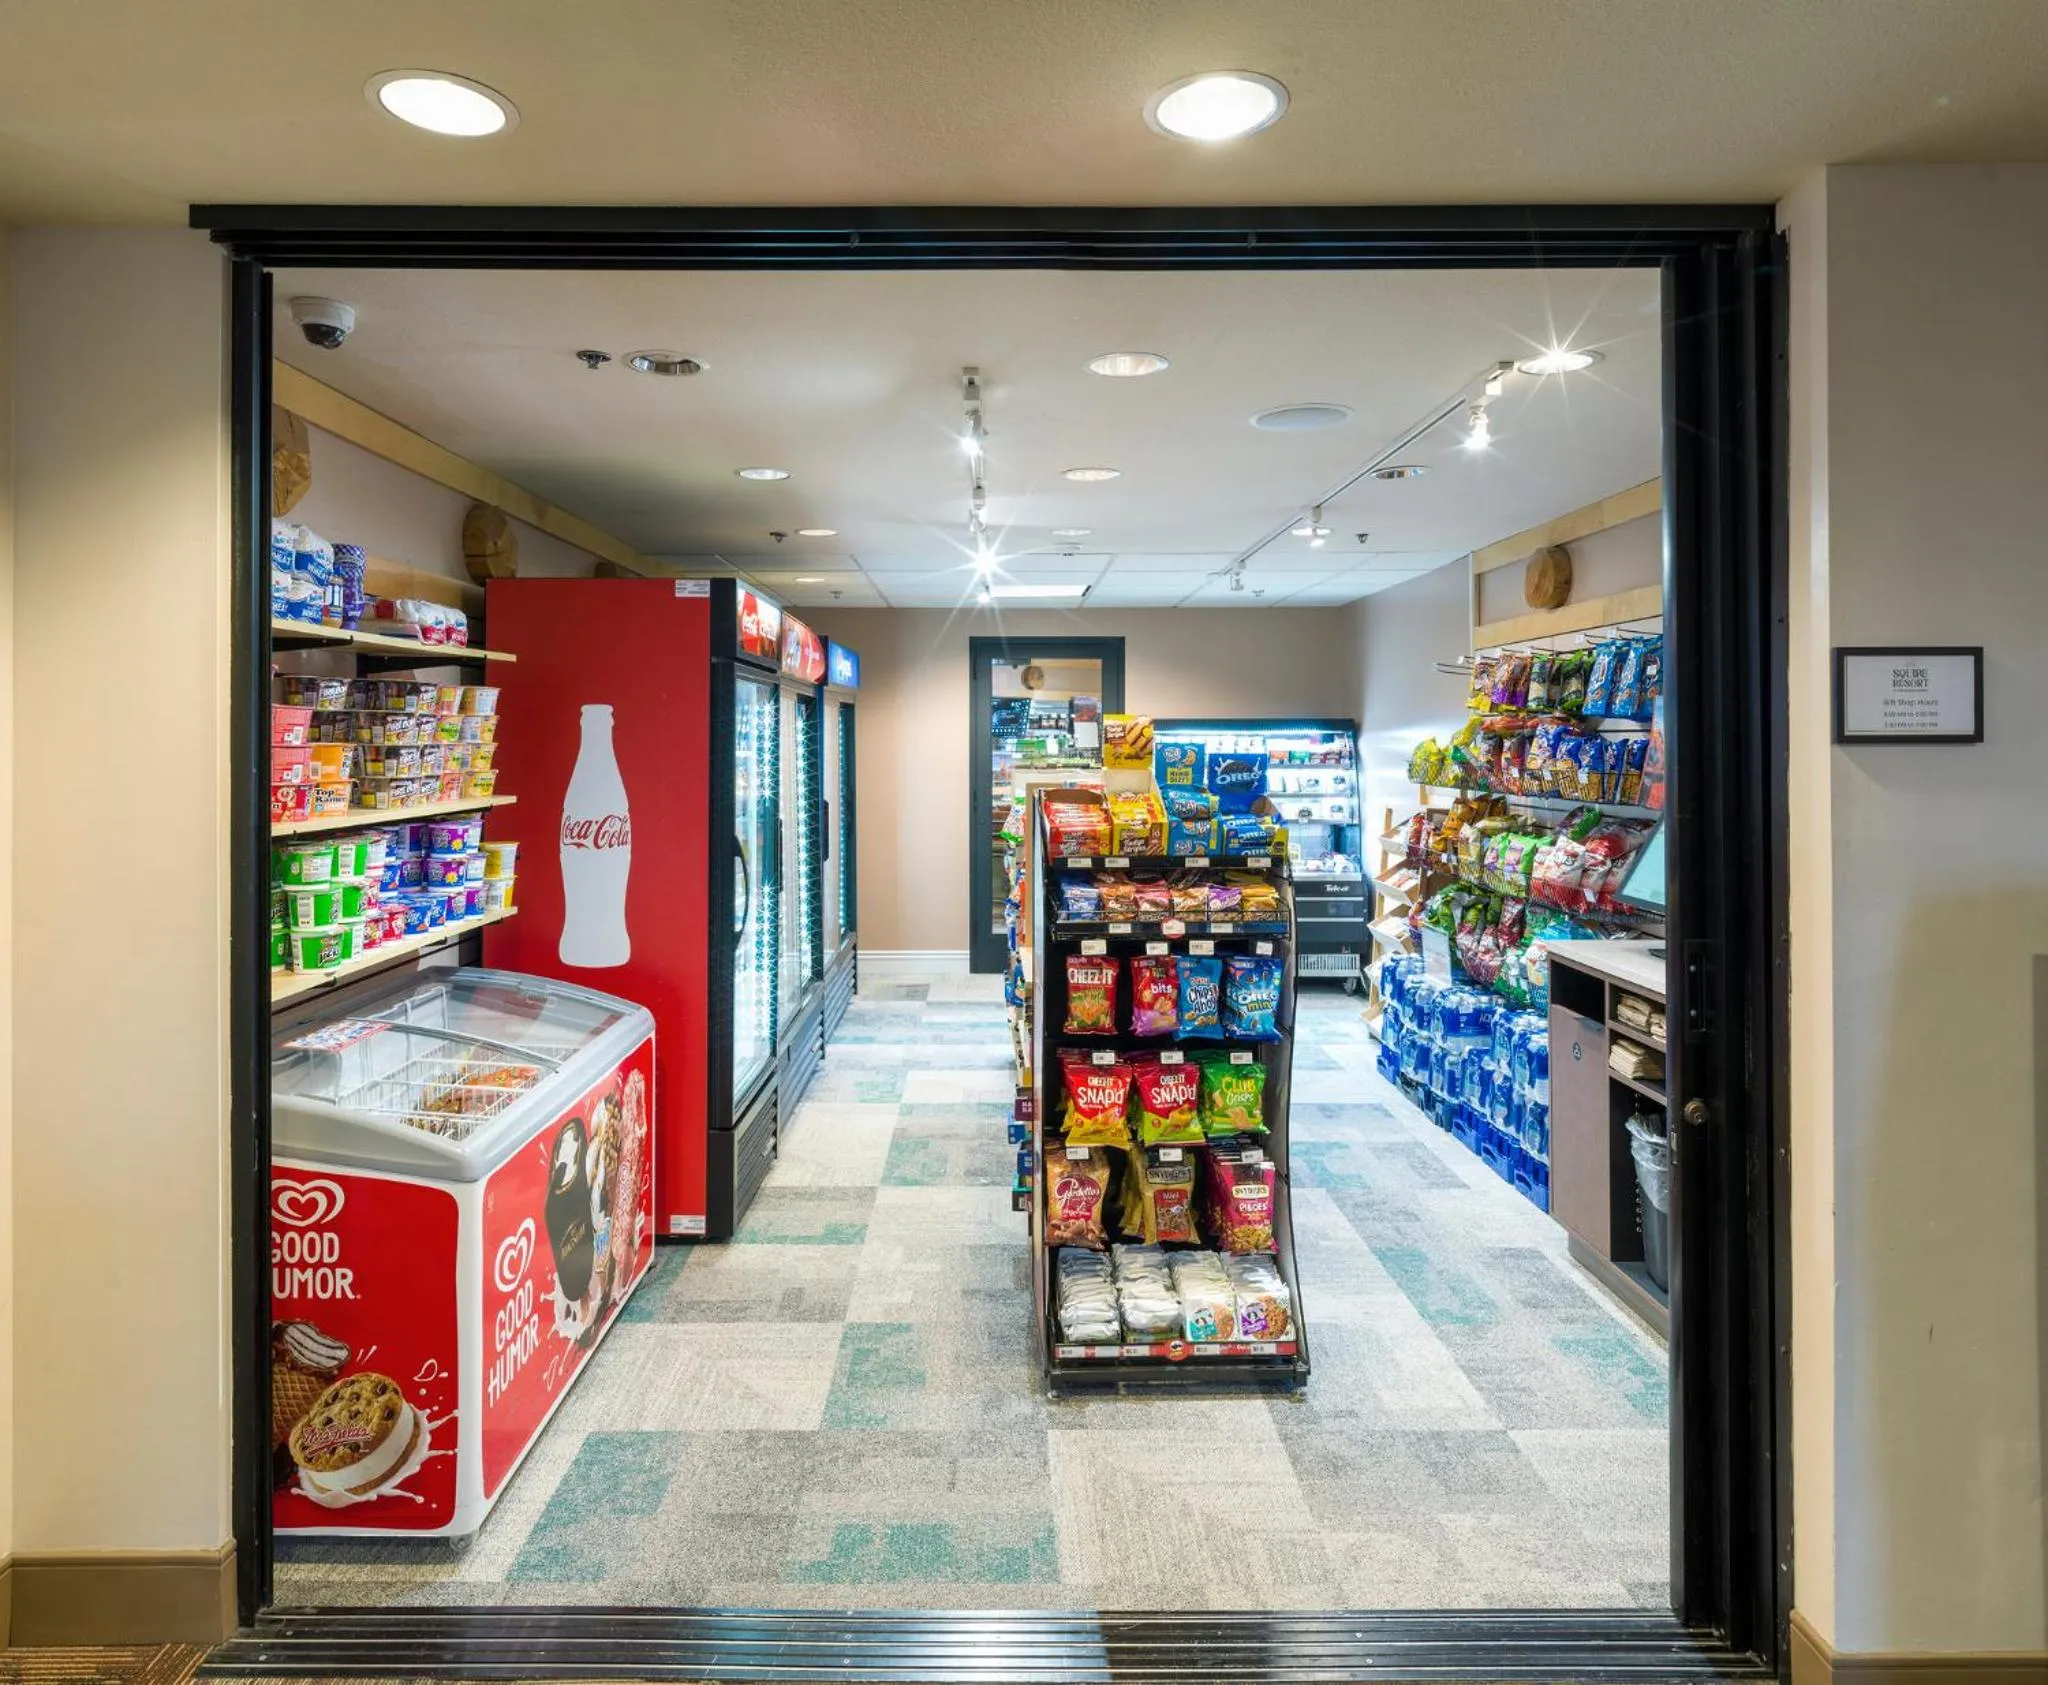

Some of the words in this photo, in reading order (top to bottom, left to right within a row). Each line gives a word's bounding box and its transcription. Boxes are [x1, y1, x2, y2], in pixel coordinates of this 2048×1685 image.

[1216, 772, 1260, 784] OREO
[315, 789, 334, 797] Top
[1150, 983, 1173, 994] bits
[272, 1267, 356, 1300] UMOR
[496, 1278, 533, 1352] GOOD
[488, 1313, 539, 1408] HUMOR
